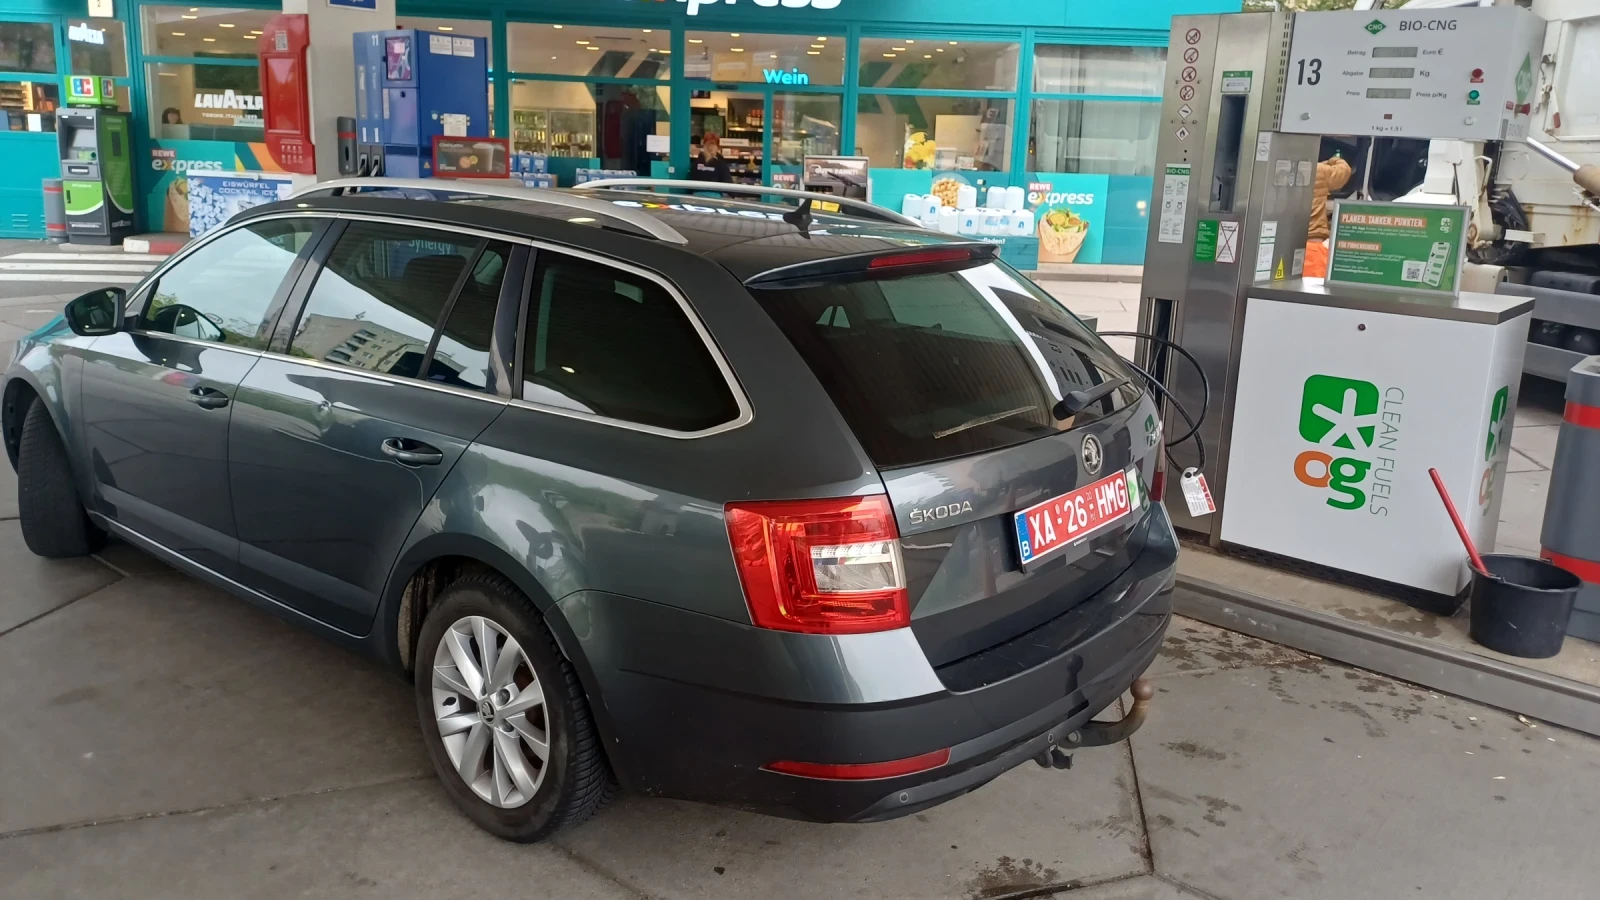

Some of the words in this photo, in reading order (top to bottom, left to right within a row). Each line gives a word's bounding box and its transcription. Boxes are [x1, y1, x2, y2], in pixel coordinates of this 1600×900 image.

[1399, 20, 1458, 31] BIO-CNG
[371, 34, 379, 46] 11
[763, 68, 809, 85] Wein
[1297, 58, 1323, 86] 13
[151, 150, 176, 158] REWE
[151, 158, 223, 174] express
[218, 187, 259, 196] COCKTAIL
[222, 180, 271, 189] EISWÜRFEL
[1029, 183, 1051, 191] REWE
[1027, 193, 1094, 207] express
[1379, 386, 1405, 451] CLEAN
[1369, 456, 1395, 517] FUELS
[909, 500, 973, 525] ŠKODA
[1021, 540, 1031, 557] B
